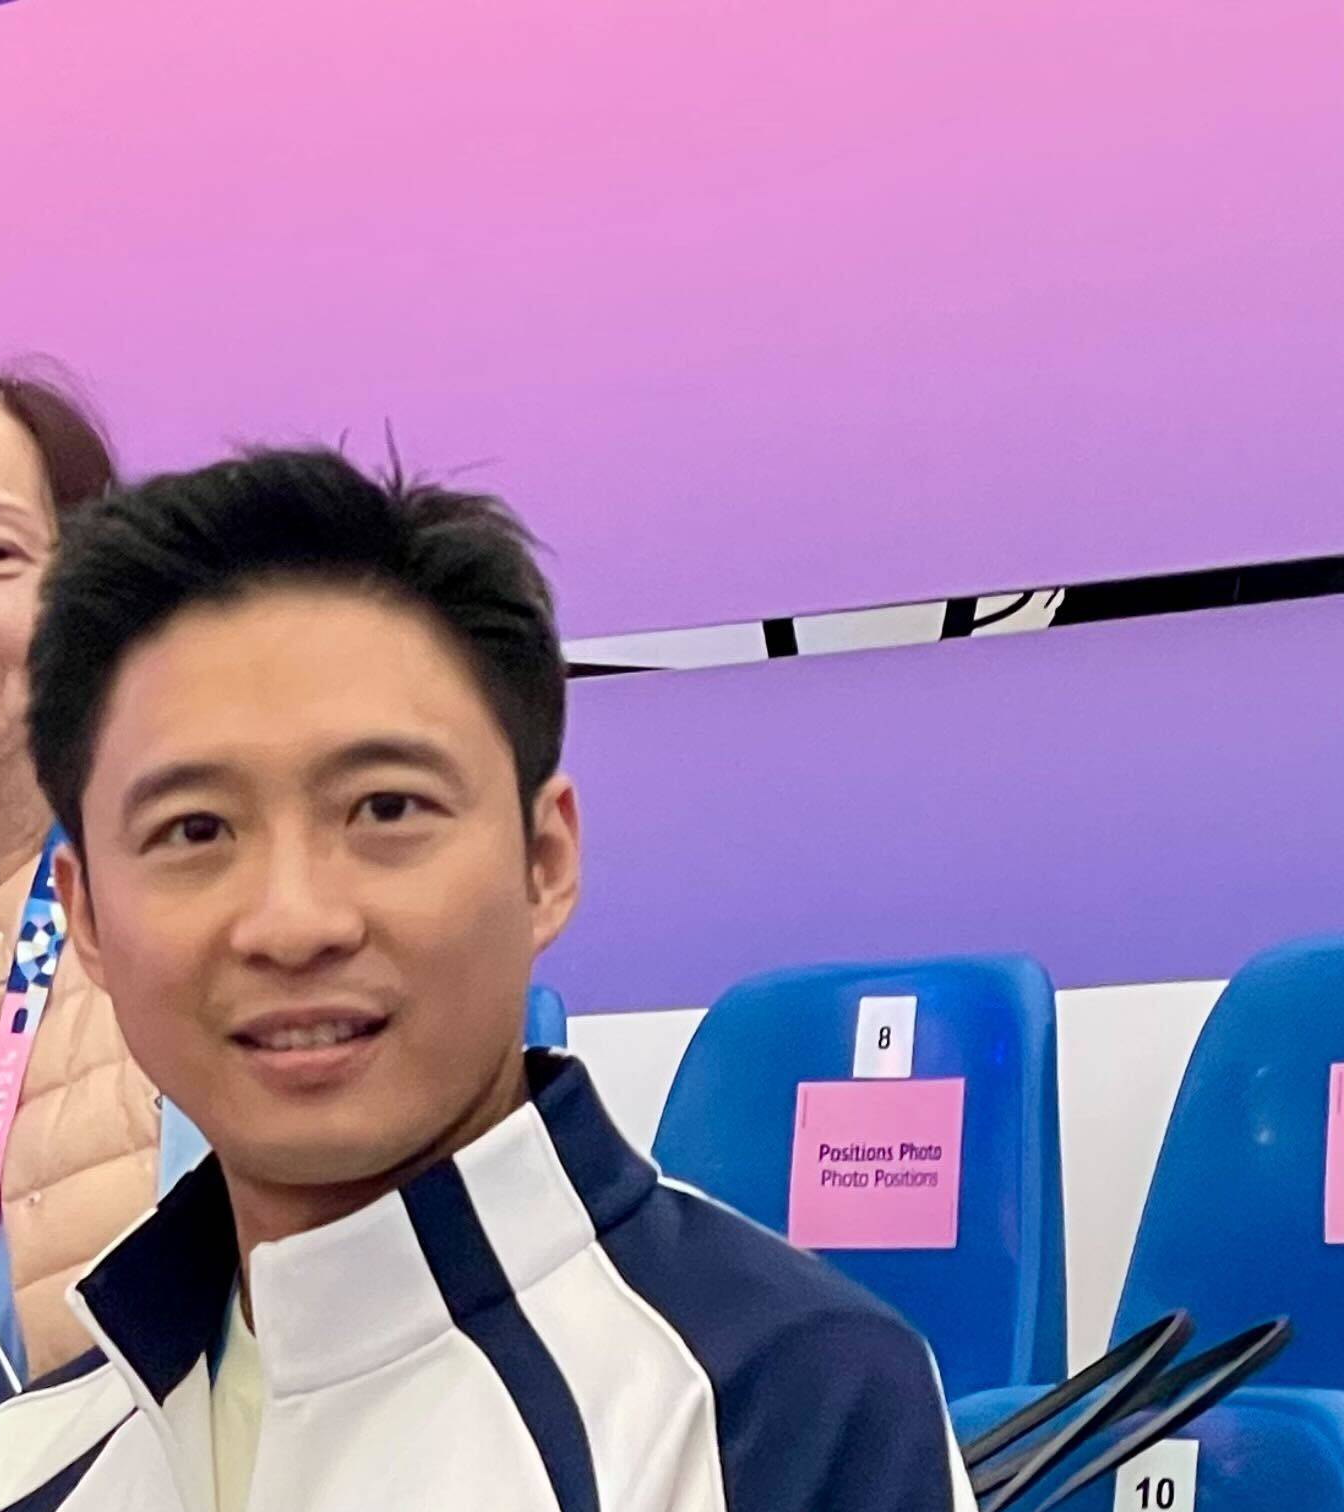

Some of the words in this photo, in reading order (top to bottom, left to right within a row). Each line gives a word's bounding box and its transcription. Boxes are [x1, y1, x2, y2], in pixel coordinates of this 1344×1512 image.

[878, 1026, 891, 1050] 8
[818, 1142, 894, 1162] Positions
[898, 1142, 943, 1162] Photo
[820, 1169, 870, 1188] Photo
[873, 1168, 940, 1188] Positions
[1135, 1476, 1175, 1510] 10
